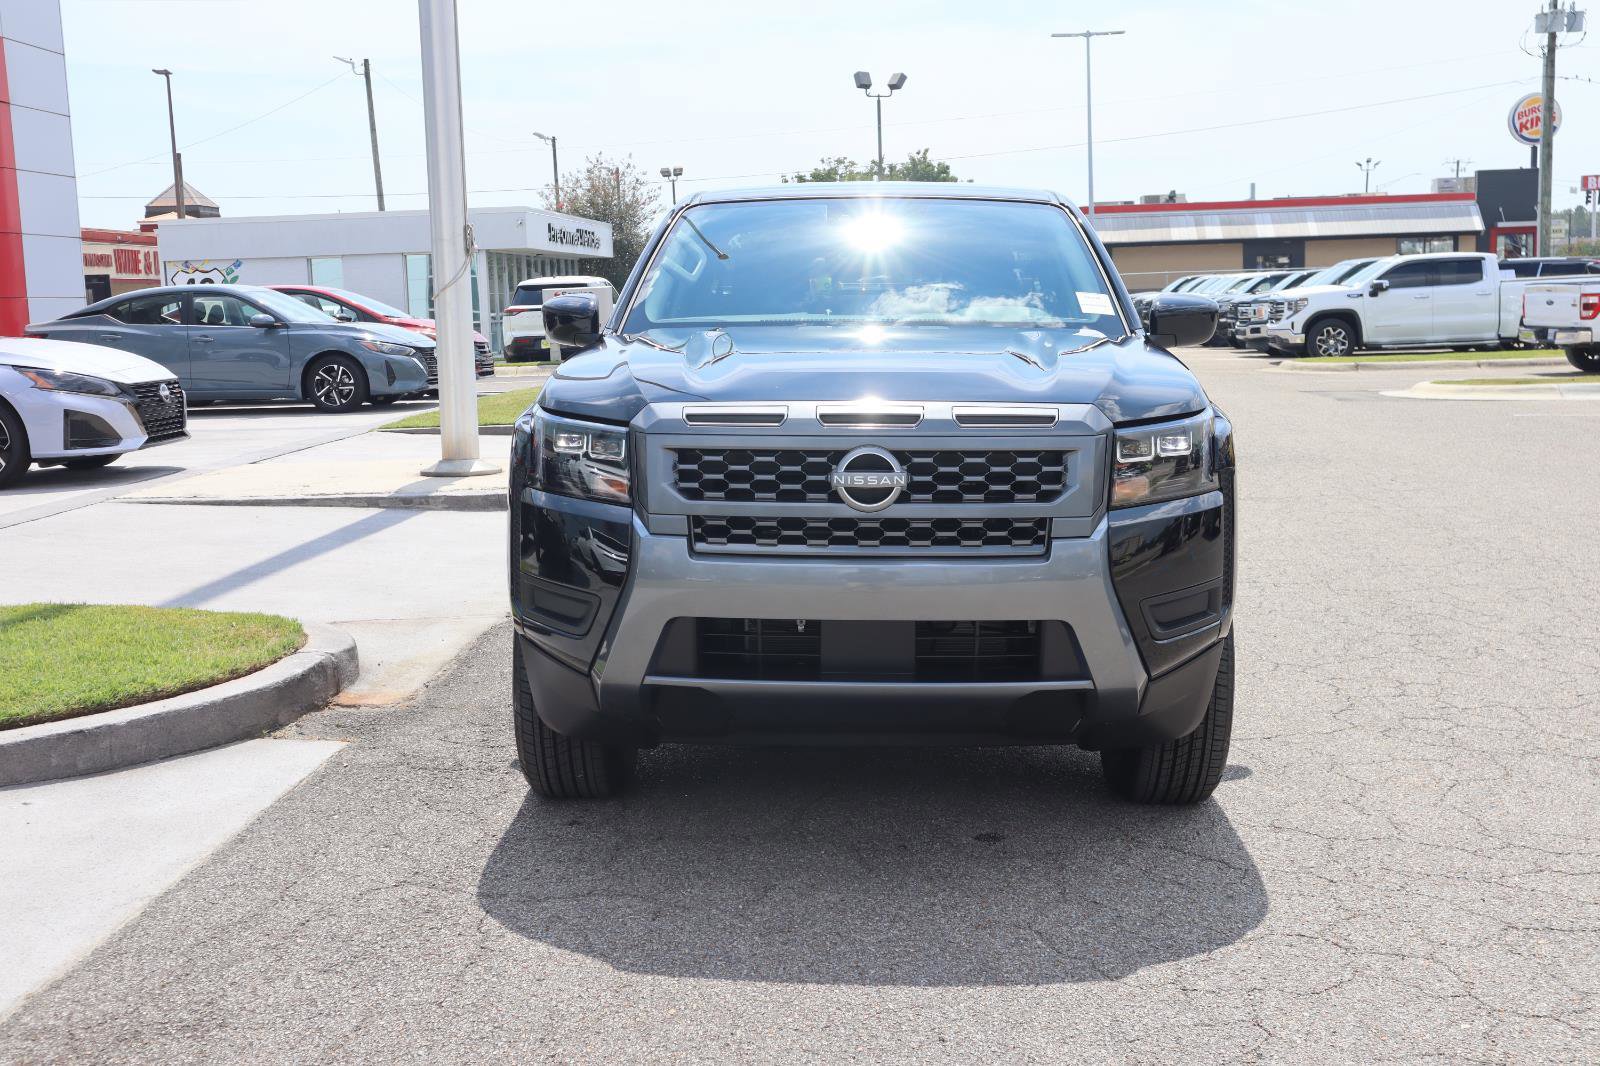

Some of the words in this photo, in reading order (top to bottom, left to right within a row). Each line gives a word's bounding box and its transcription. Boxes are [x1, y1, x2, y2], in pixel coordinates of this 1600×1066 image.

[113, 248, 142, 275] WINE
[143, 250, 152, 275] &
[833, 475, 905, 485] NISSAN
